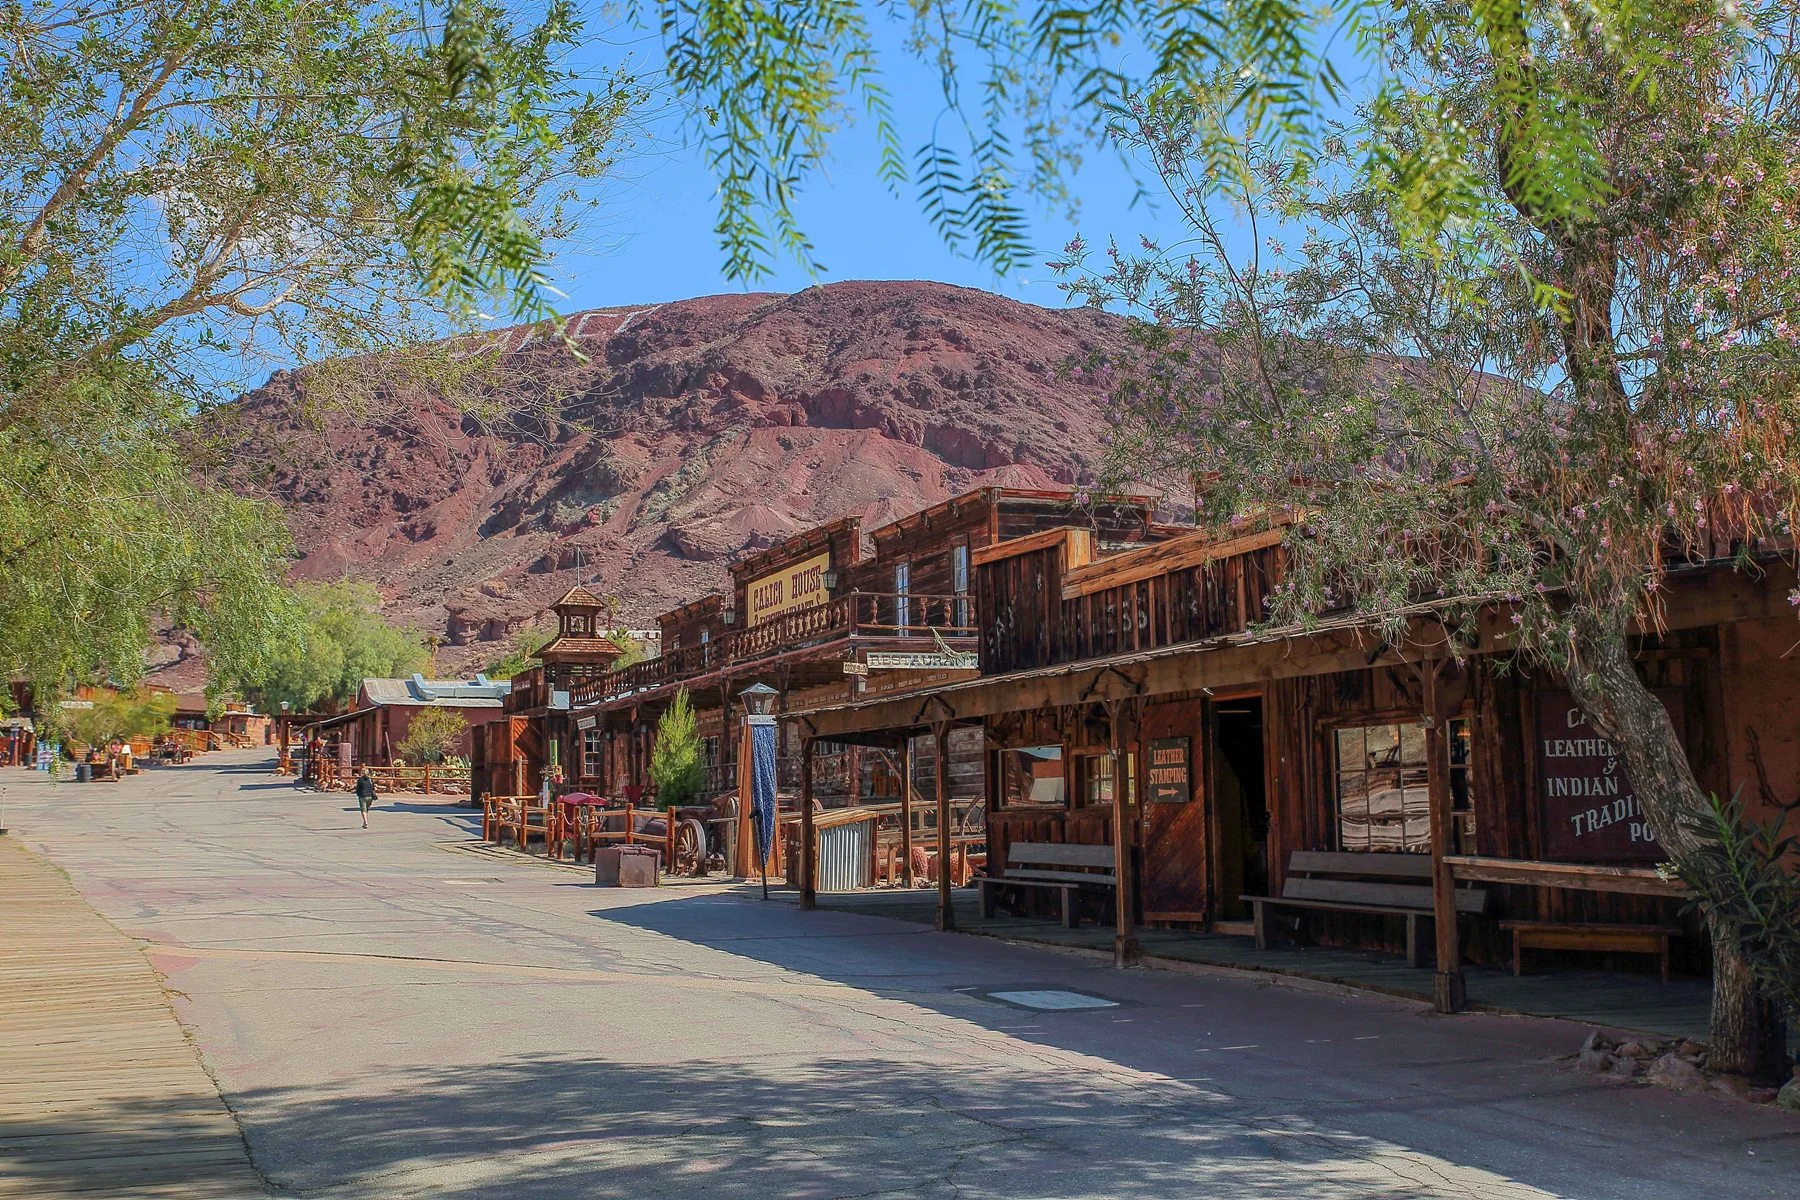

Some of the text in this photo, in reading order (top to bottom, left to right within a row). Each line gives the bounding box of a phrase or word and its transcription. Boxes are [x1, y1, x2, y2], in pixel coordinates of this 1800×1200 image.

[754, 580, 783, 612] CALICO
[792, 564, 821, 599] HOUSE
[869, 654, 978, 667] RESTAURANT
[1153, 748, 1184, 765] LEATHER
[1602, 757, 1617, 775] &
[1149, 767, 1187, 785] STAMPING
[1546, 776, 1618, 797] INDIAN
[1571, 794, 1641, 837] TRADI
[1628, 822, 1656, 842] PO
